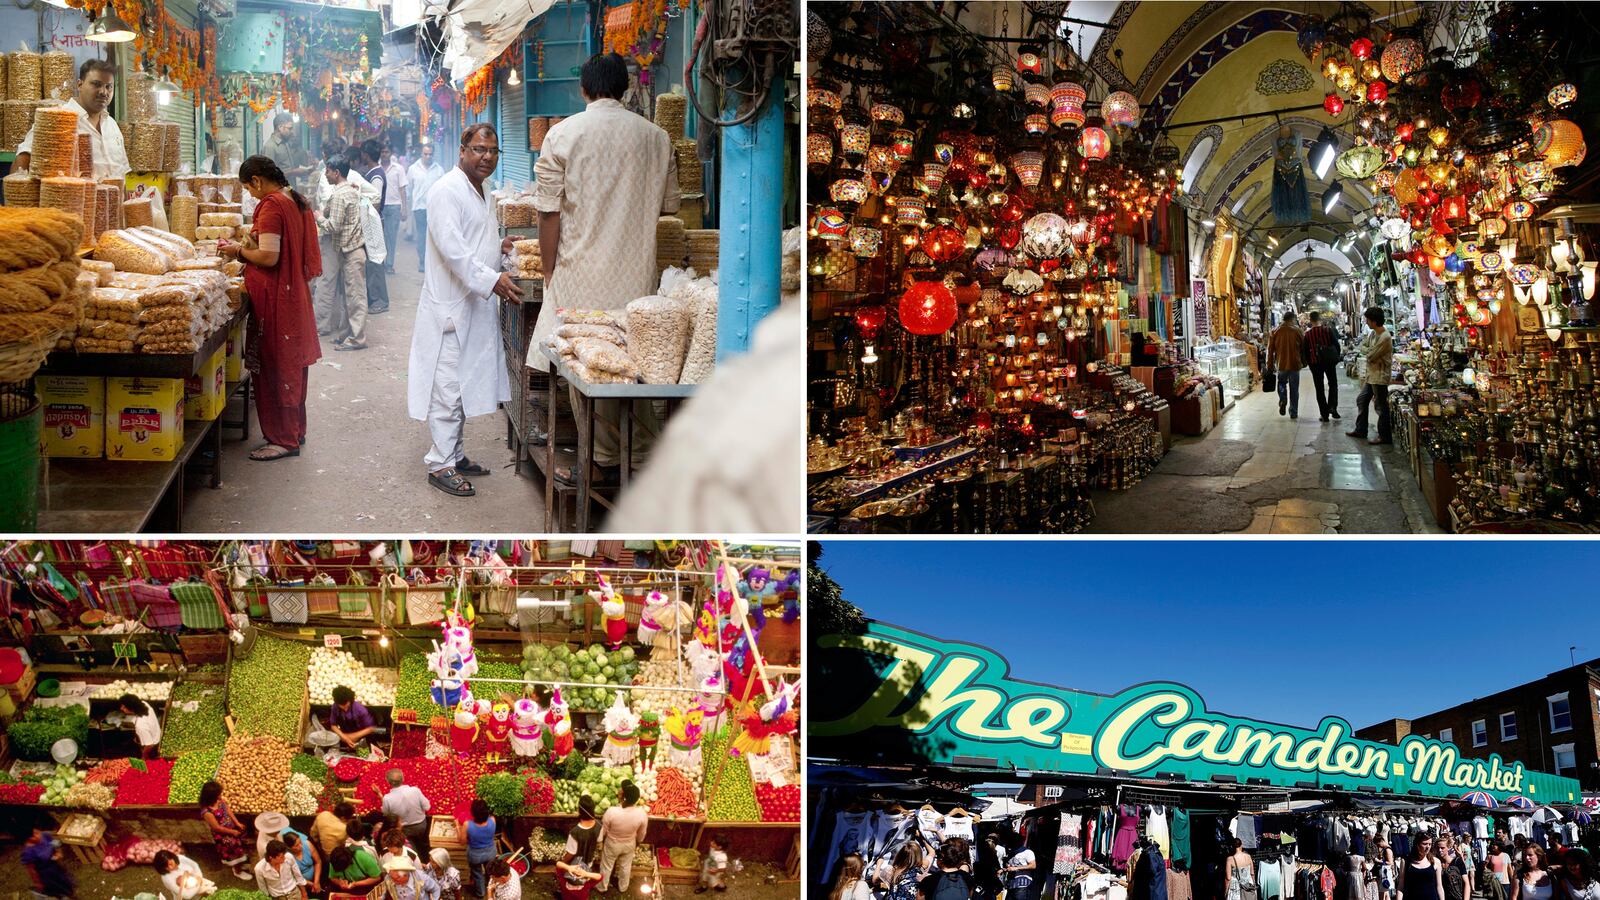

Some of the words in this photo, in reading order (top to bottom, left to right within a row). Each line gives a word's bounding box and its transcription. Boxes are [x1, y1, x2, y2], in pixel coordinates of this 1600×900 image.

[45, 412, 88, 427] Vasudev
[807, 632, 1058, 746] The
[1098, 693, 1388, 778] Camden
[1405, 740, 1524, 793] Market
